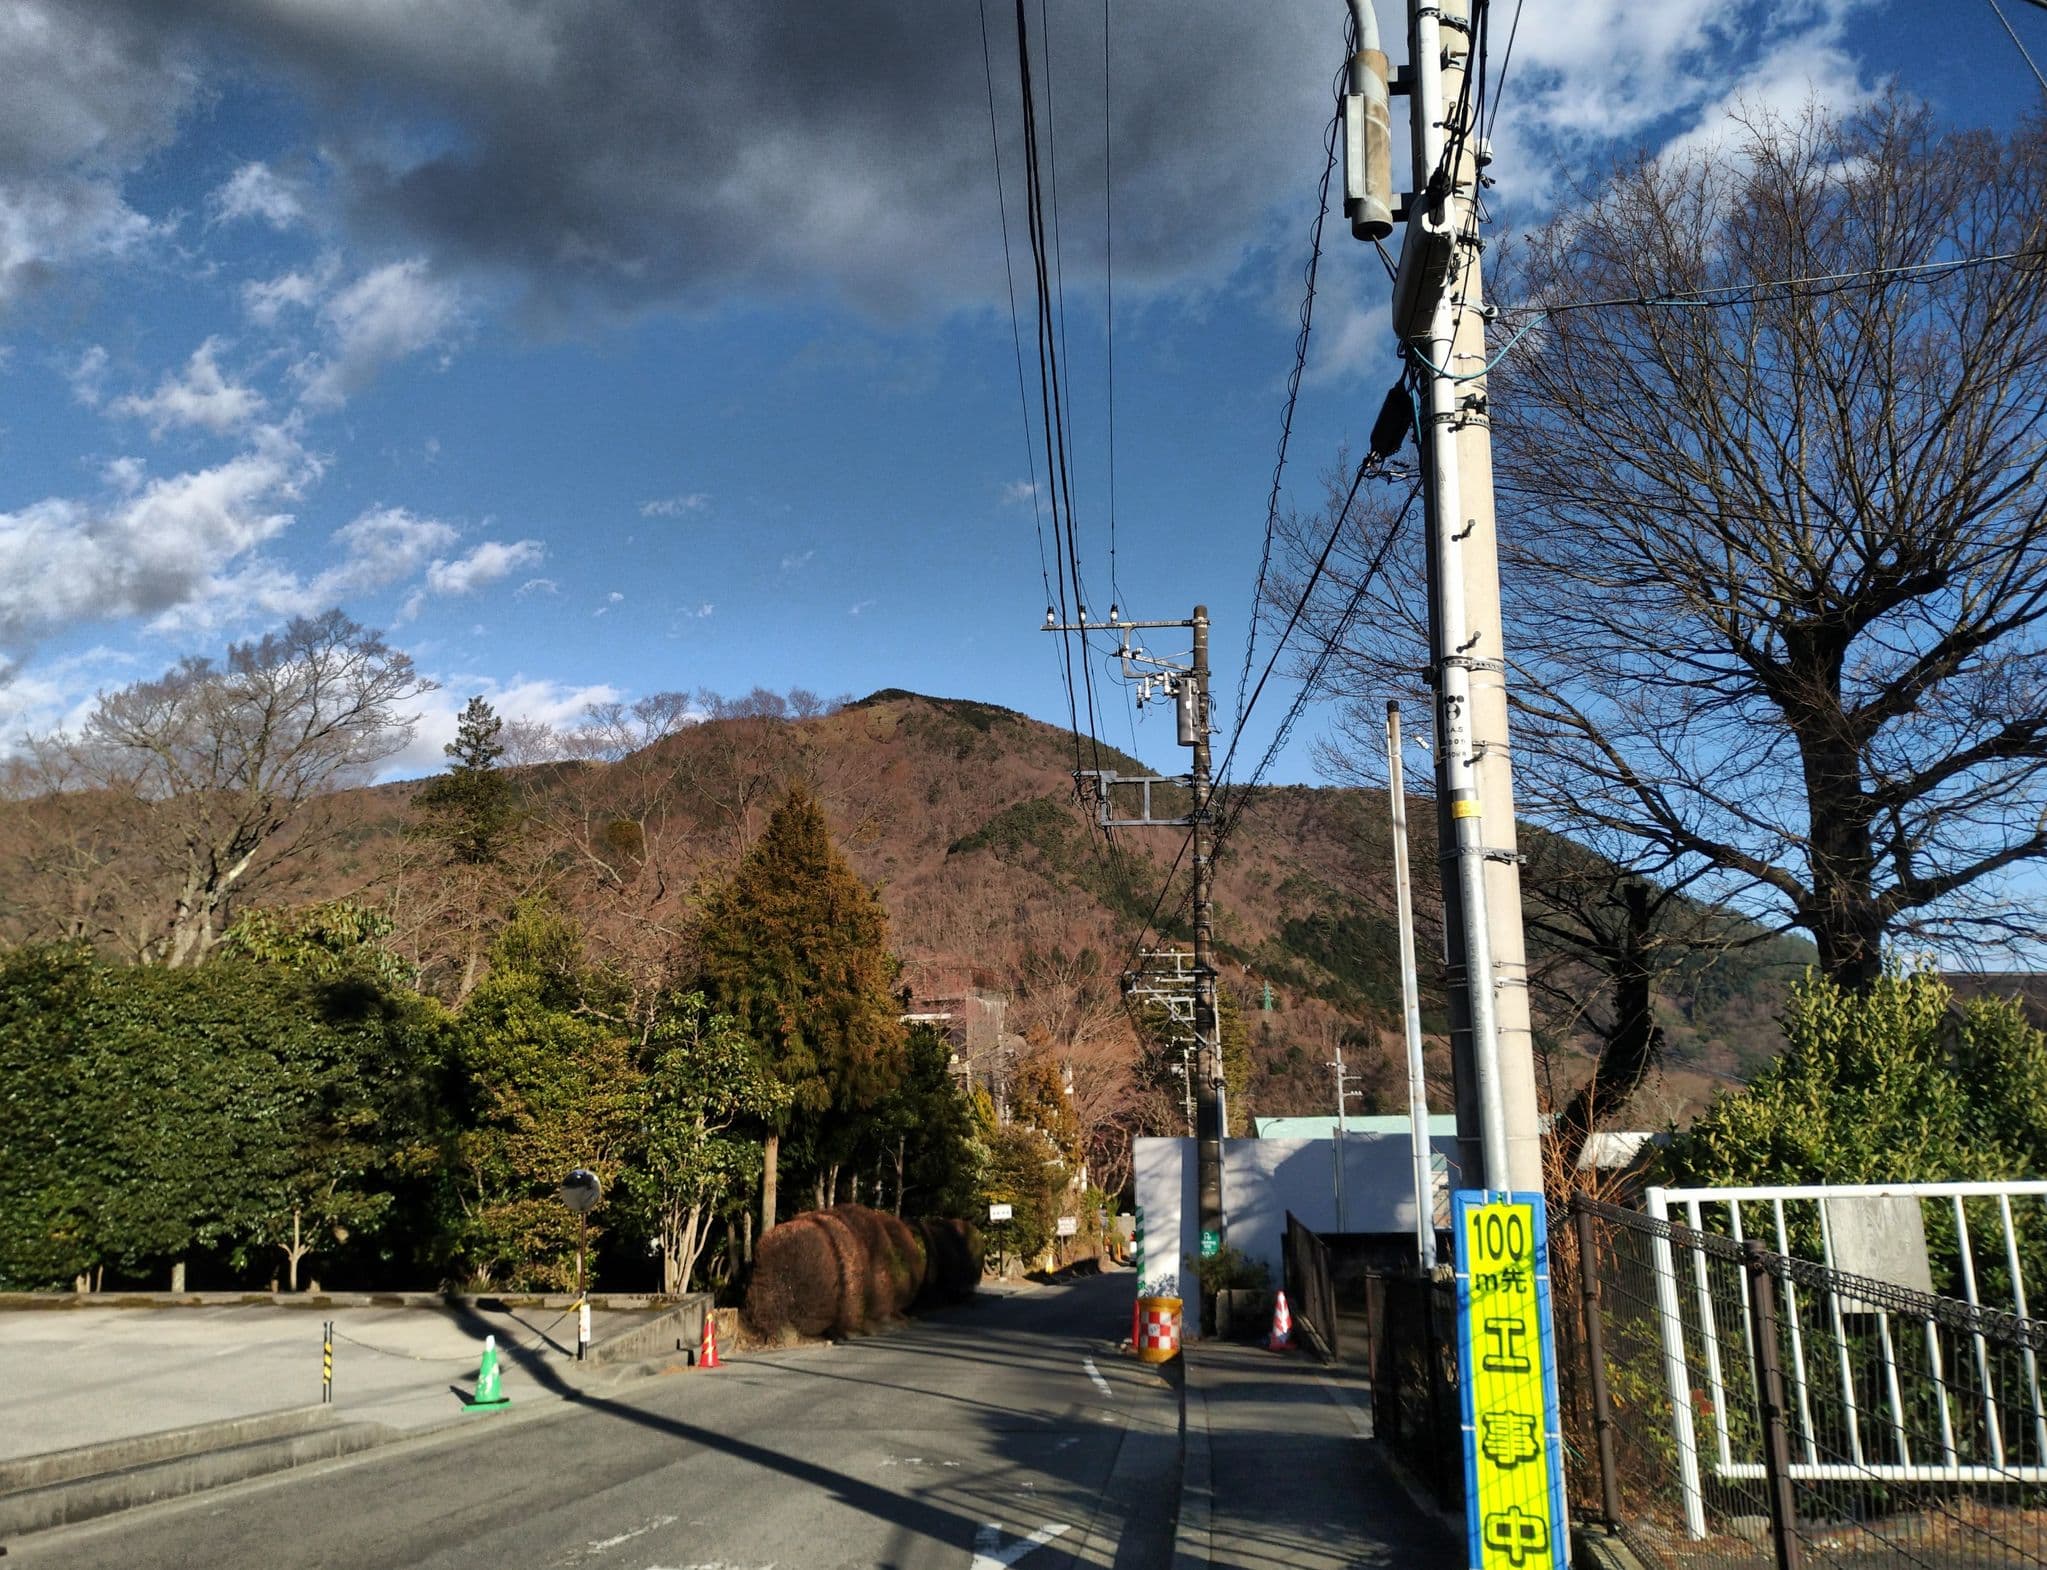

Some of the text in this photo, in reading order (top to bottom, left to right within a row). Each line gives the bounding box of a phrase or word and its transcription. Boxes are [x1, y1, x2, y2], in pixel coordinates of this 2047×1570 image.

[1473, 1213, 1524, 1261] 100
[1475, 1267, 1527, 1293] m先
[1482, 1317, 1549, 1567] 工事中
